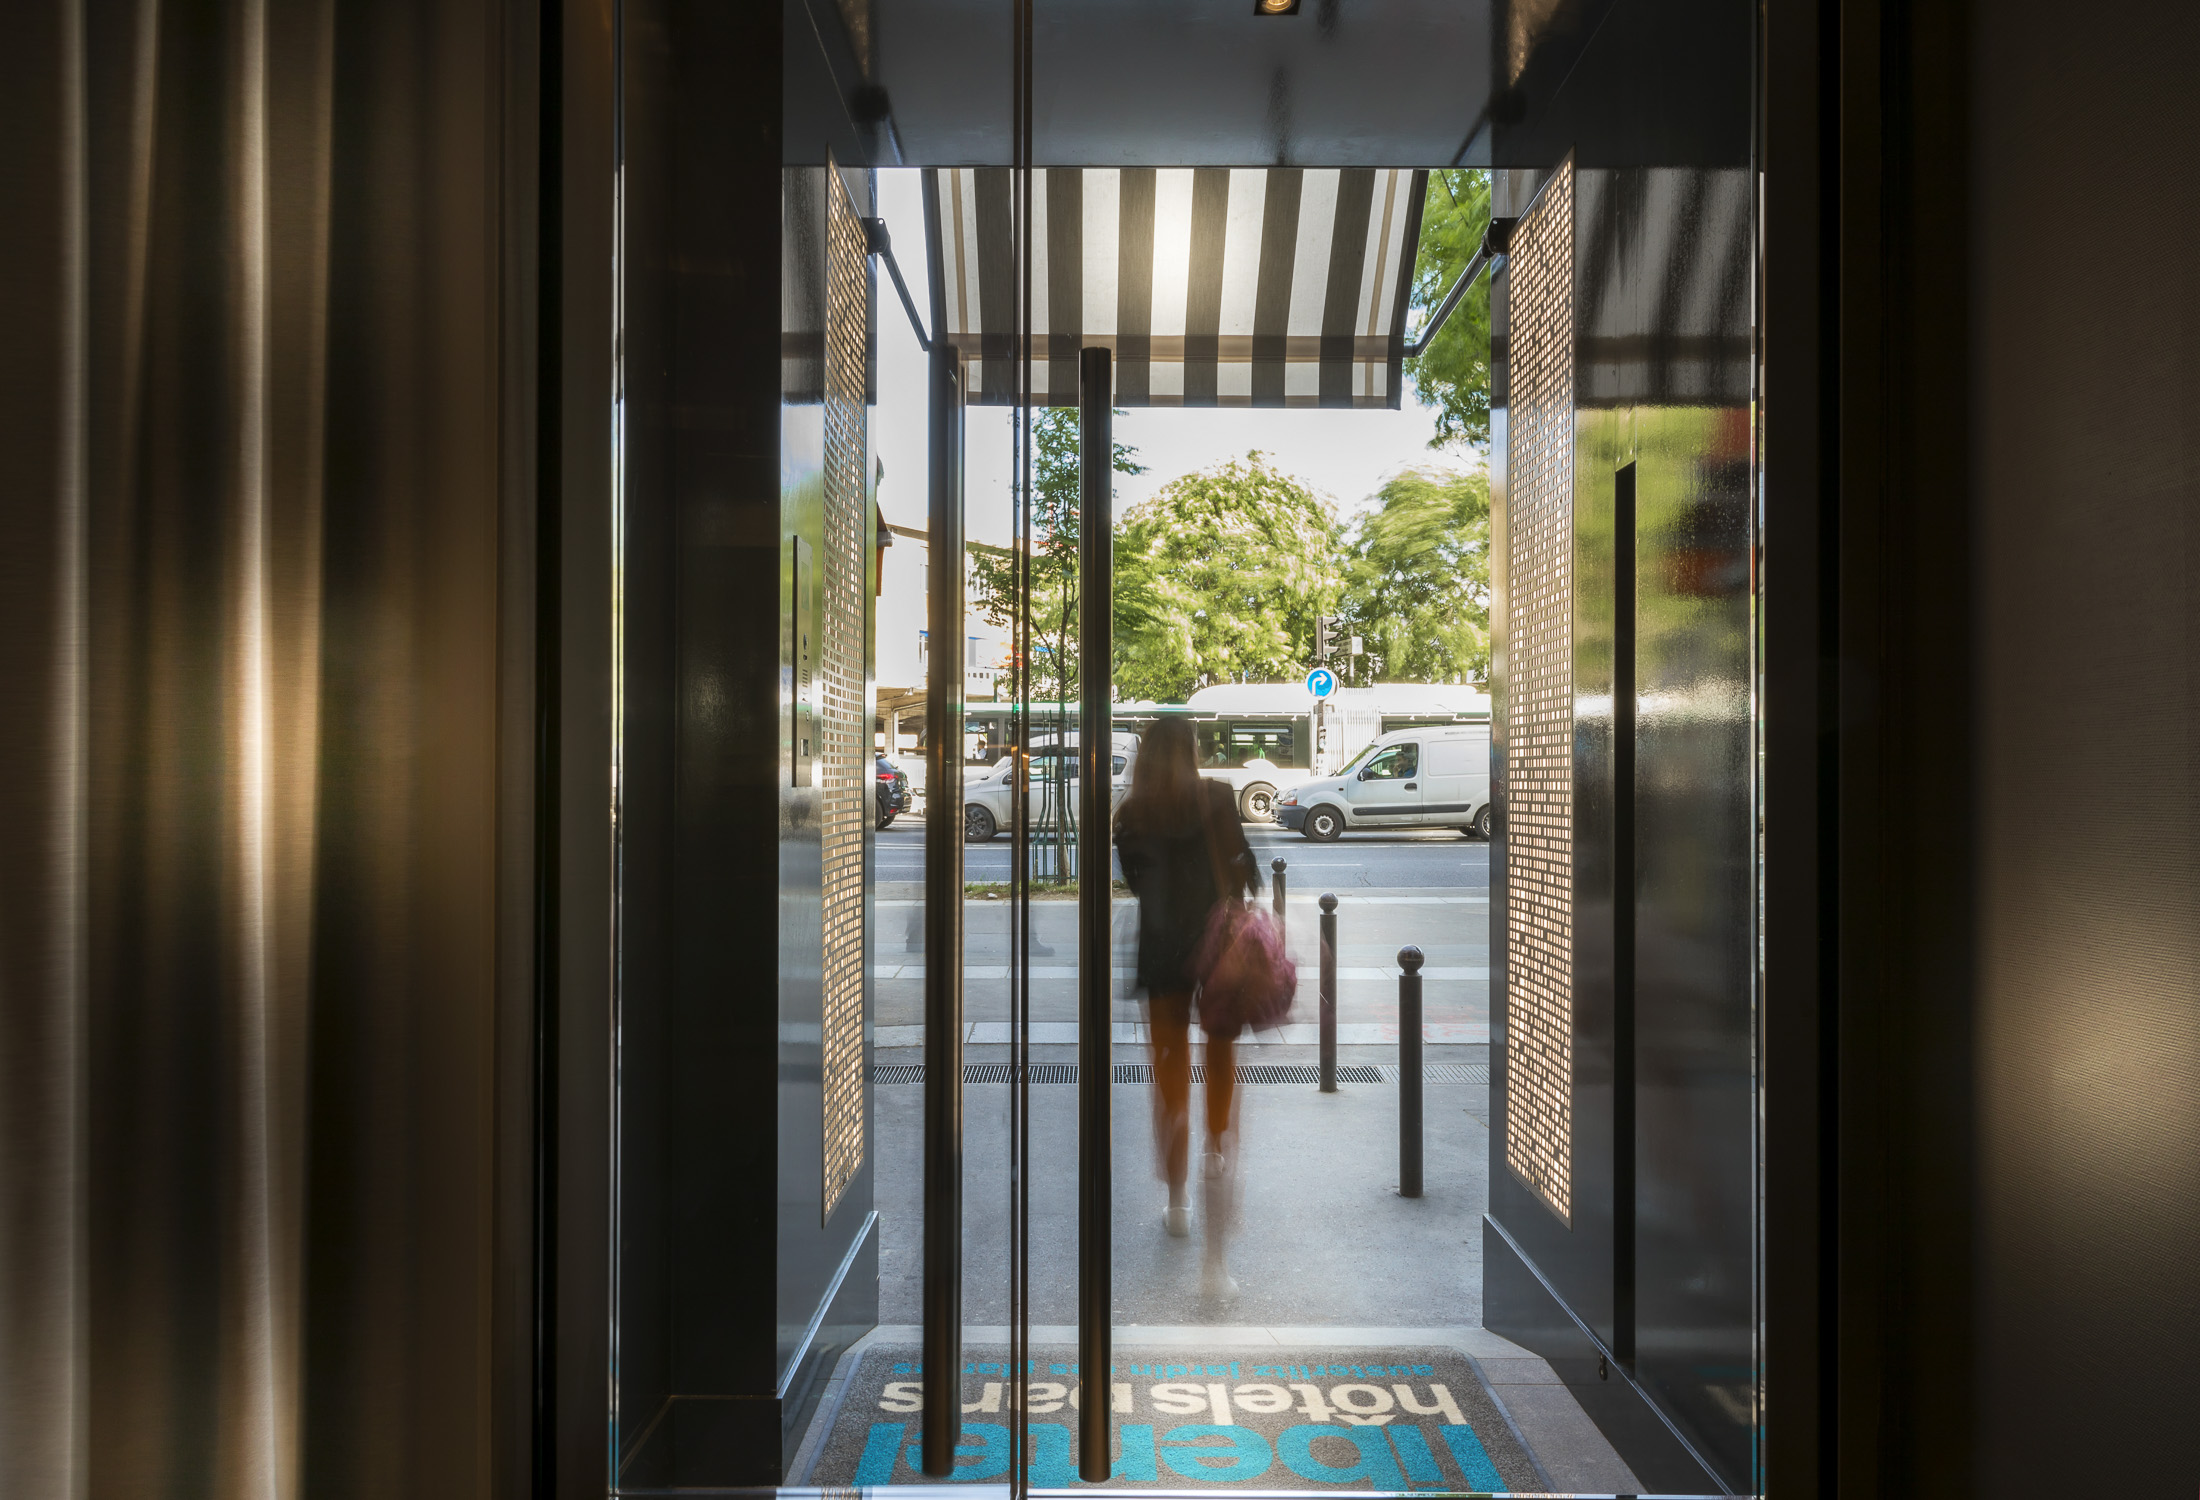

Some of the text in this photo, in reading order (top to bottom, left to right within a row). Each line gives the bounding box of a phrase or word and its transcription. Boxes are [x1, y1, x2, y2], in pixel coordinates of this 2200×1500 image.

[1130, 1361, 1241, 1379] jardin
[1252, 1364, 1435, 1379] austerlitz
[878, 1382, 1465, 1426] hôtels pars
[852, 1424, 1509, 1492] libertel
